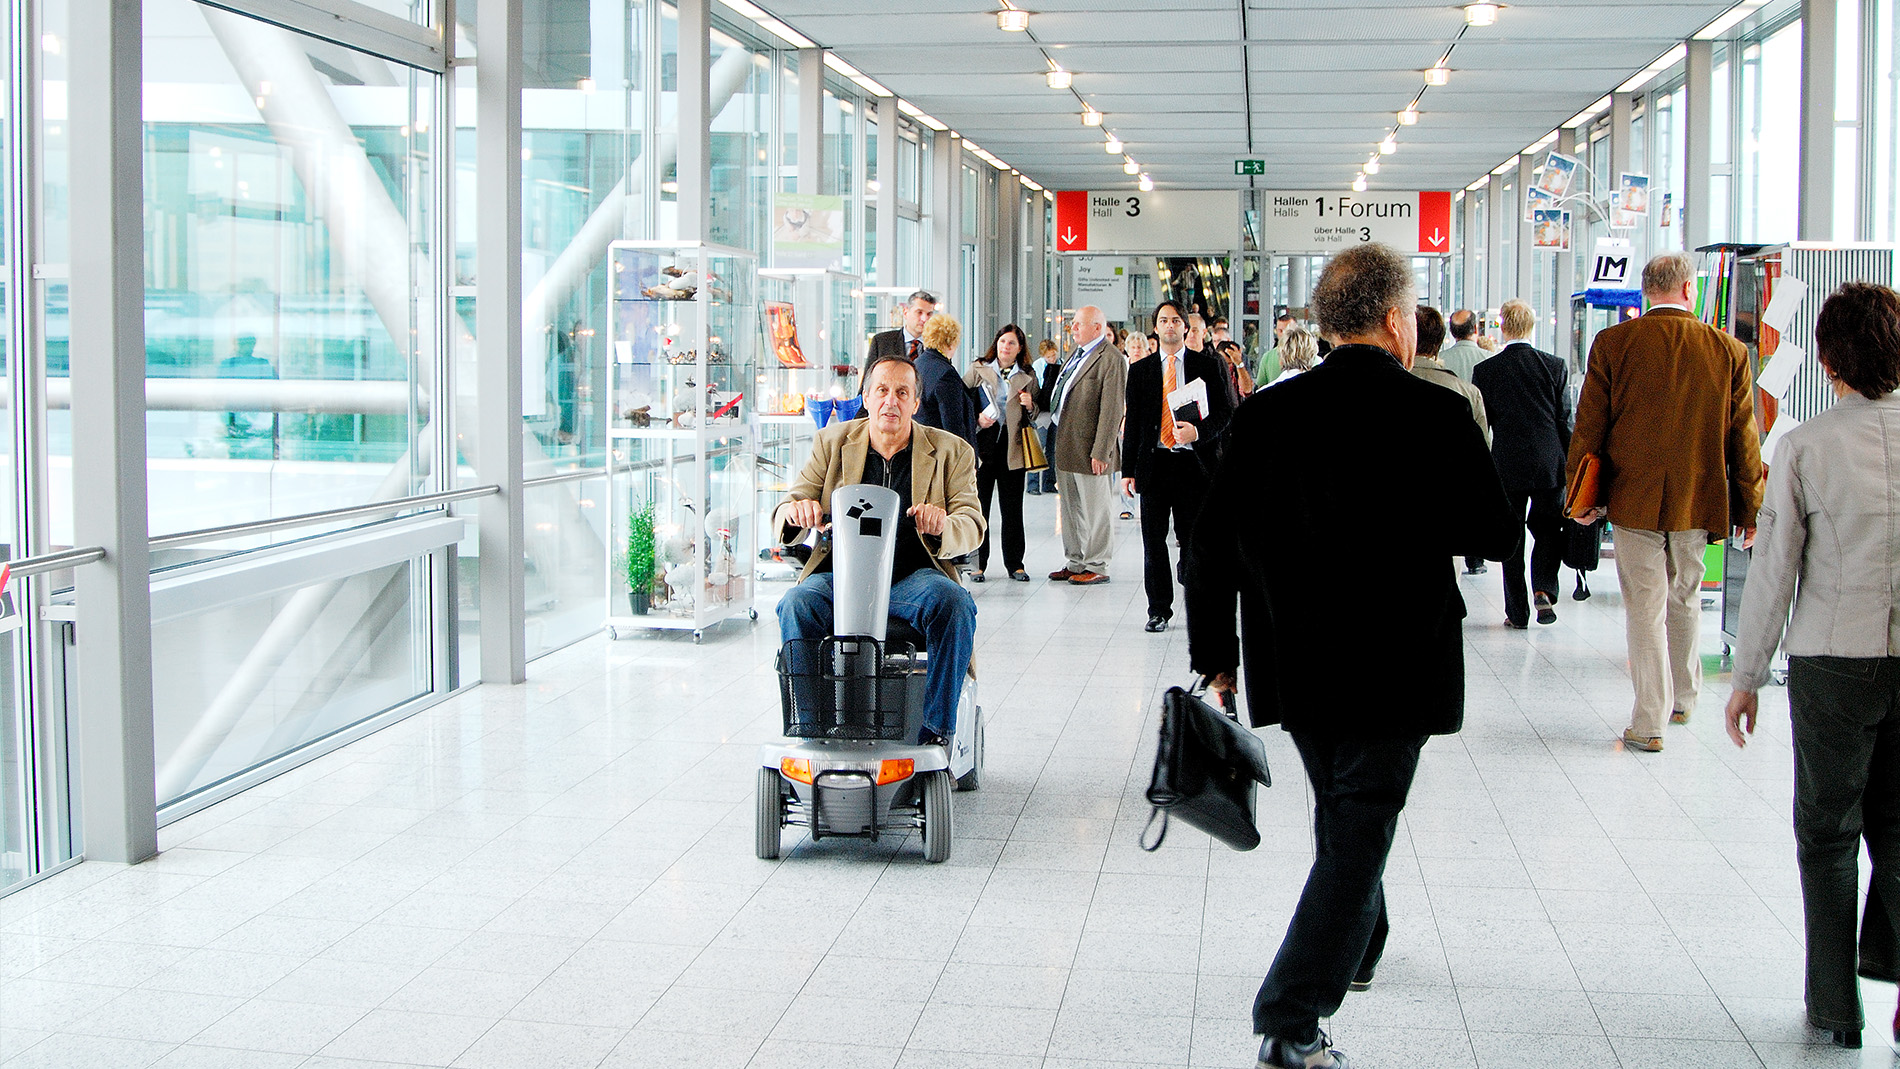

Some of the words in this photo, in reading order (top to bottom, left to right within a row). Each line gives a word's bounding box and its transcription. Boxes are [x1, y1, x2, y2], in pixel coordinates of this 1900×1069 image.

[1093, 197, 1120, 206] Halle
[1126, 197, 1141, 217] 3
[1274, 196, 1308, 206] Hallen
[1093, 208, 1112, 217] Hall
[1274, 208, 1299, 217] Halls
[1359, 227, 1371, 242] 3
[1593, 256, 1628, 282] LM
